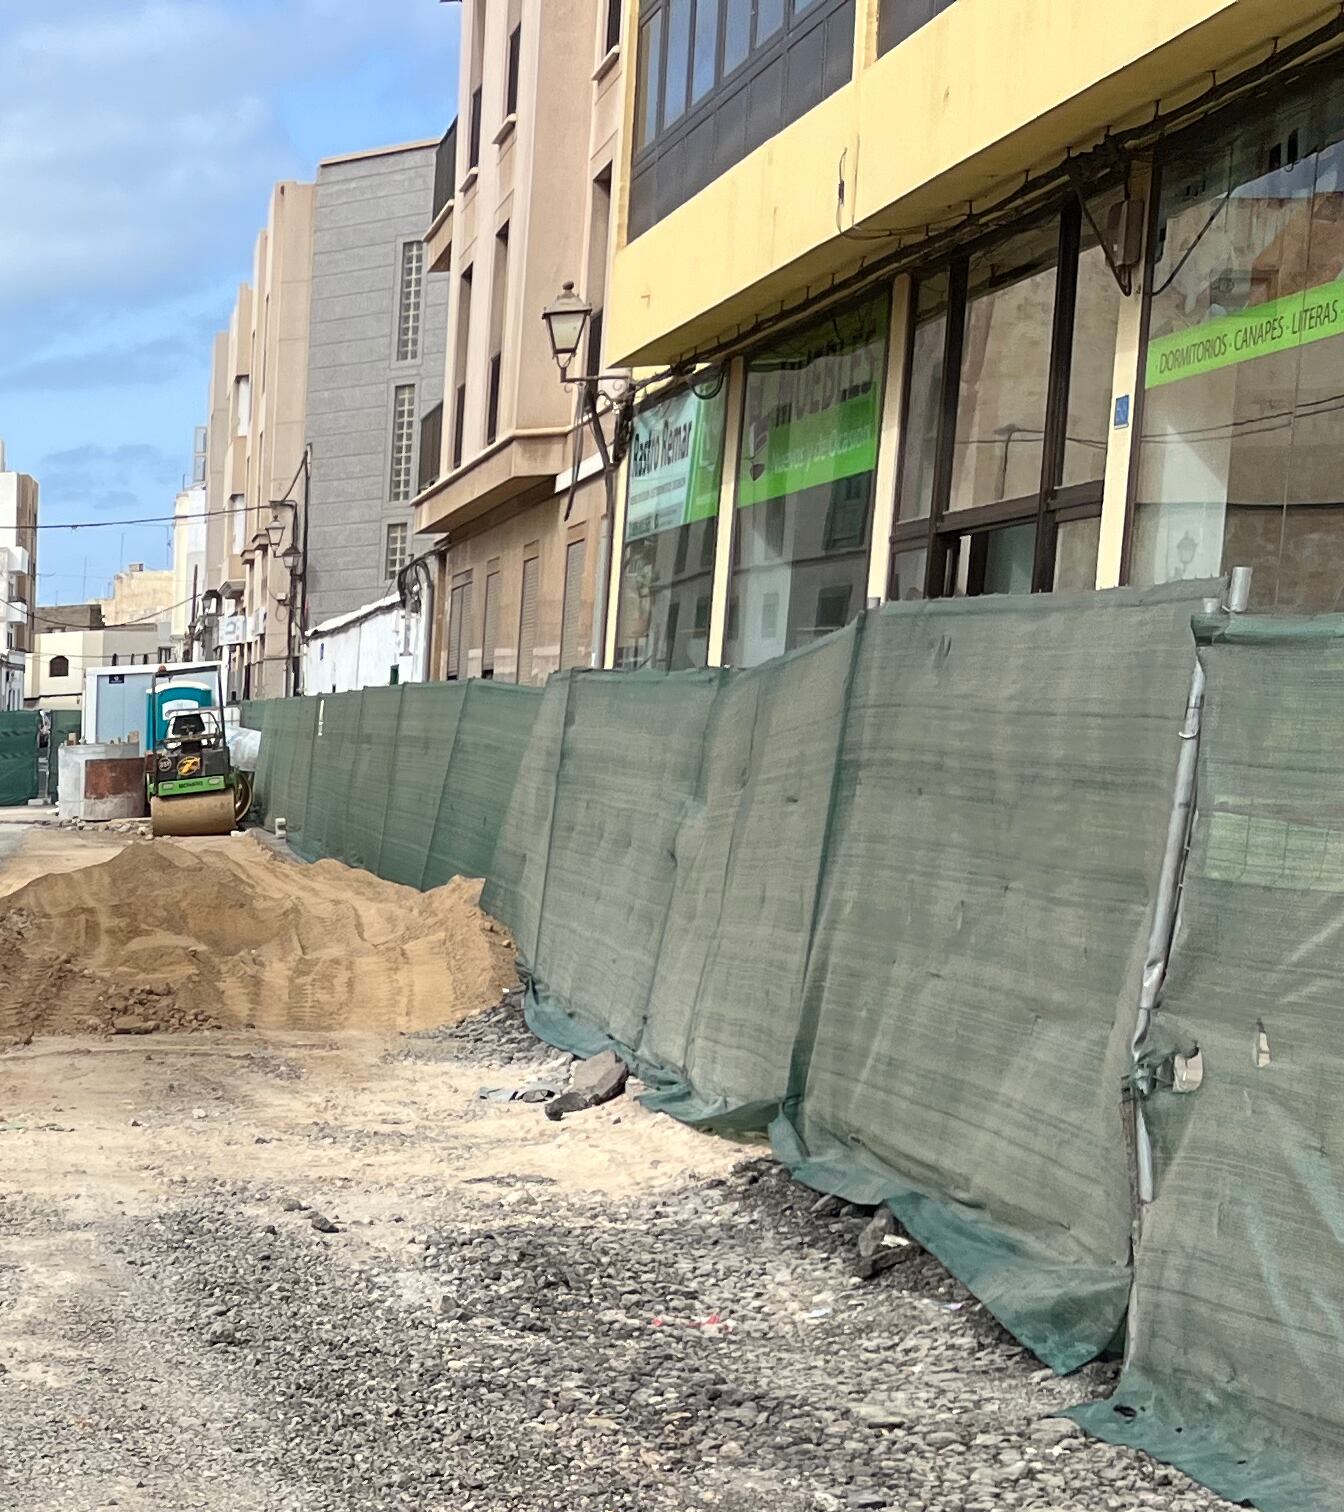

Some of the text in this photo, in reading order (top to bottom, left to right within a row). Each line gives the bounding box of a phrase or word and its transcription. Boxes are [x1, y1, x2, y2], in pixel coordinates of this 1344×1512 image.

[1160, 300, 1339, 373] DORMITORIOS CANAPES LITERAS
[663, 419, 693, 466] Remar
